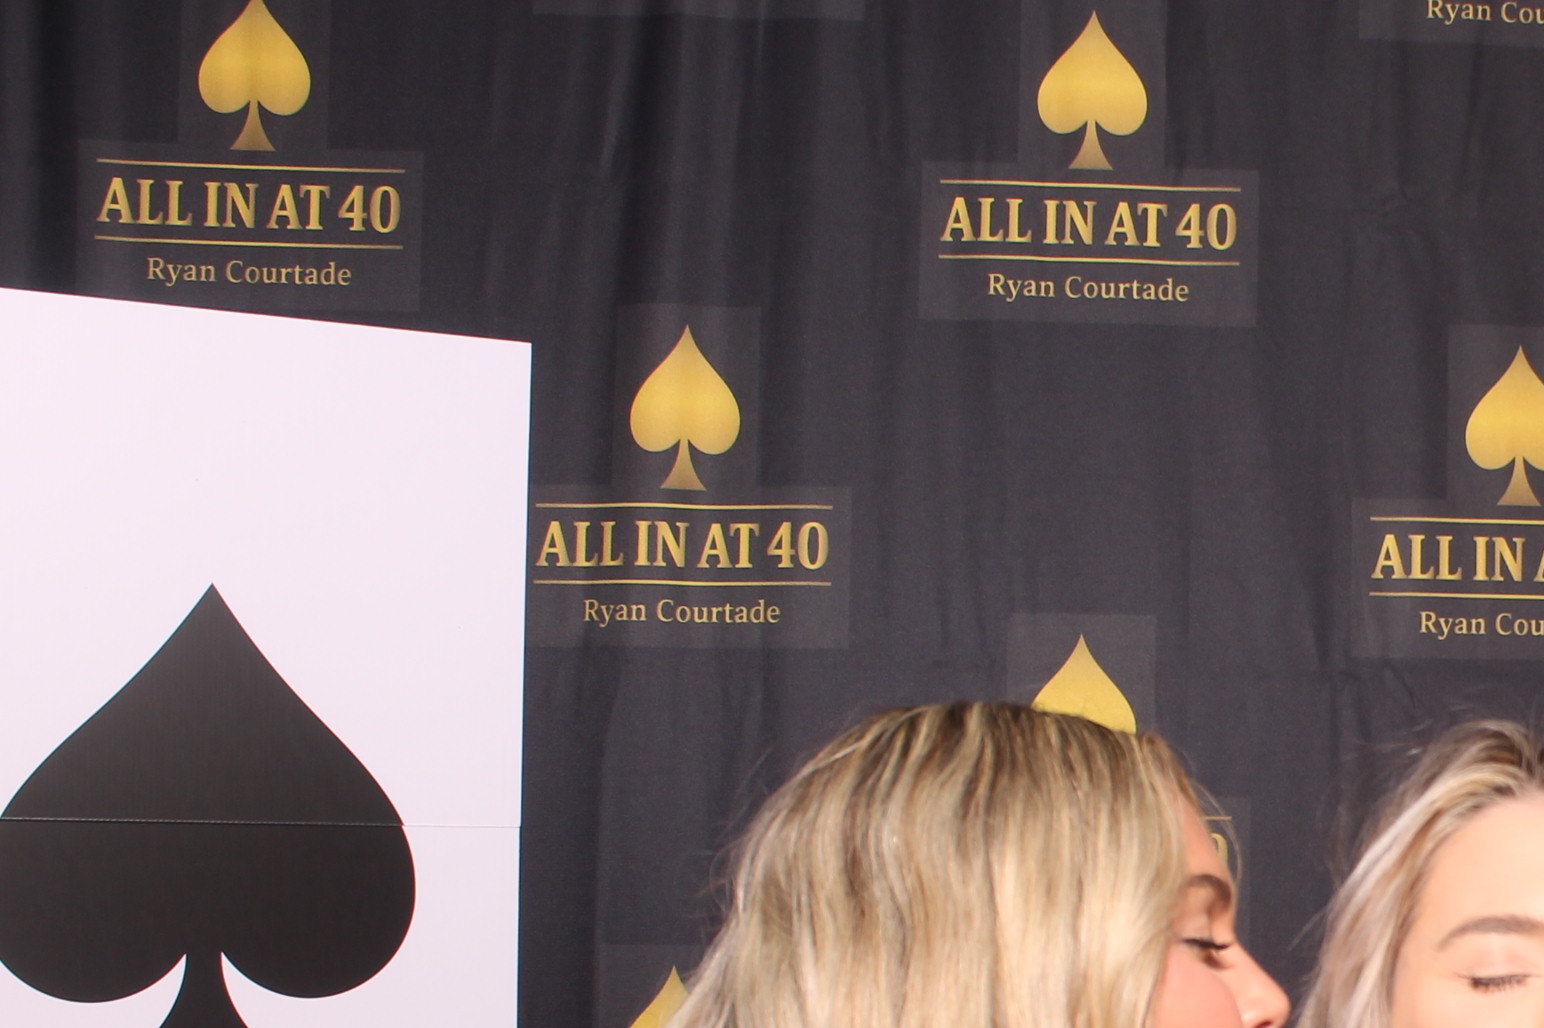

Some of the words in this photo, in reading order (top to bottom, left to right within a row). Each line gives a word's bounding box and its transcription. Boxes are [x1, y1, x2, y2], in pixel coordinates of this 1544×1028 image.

[1426, 0, 1492, 25] Ryan
[97, 176, 192, 227] ALL
[203, 181, 257, 229] IN
[266, 183, 330, 232] AT
[338, 184, 400, 233] 40
[940, 196, 1032, 243] ALL
[1042, 198, 1095, 245] IN
[1104, 200, 1168, 248] AT
[1176, 202, 1237, 251] 40
[146, 256, 216, 287] Ryan
[225, 259, 352, 287] Courtade
[986, 272, 1055, 302] Ryan
[1064, 275, 1190, 302] Courtade
[536, 520, 623, 568] ALL
[634, 520, 688, 569] IN
[696, 522, 759, 570] AT
[766, 521, 829, 570] 40
[1371, 533, 1463, 581] ALL
[1473, 536, 1525, 582] IN
[583, 598, 647, 628] Ryan
[655, 598, 781, 625] Courtade
[1418, 610, 1486, 640] Ryan
